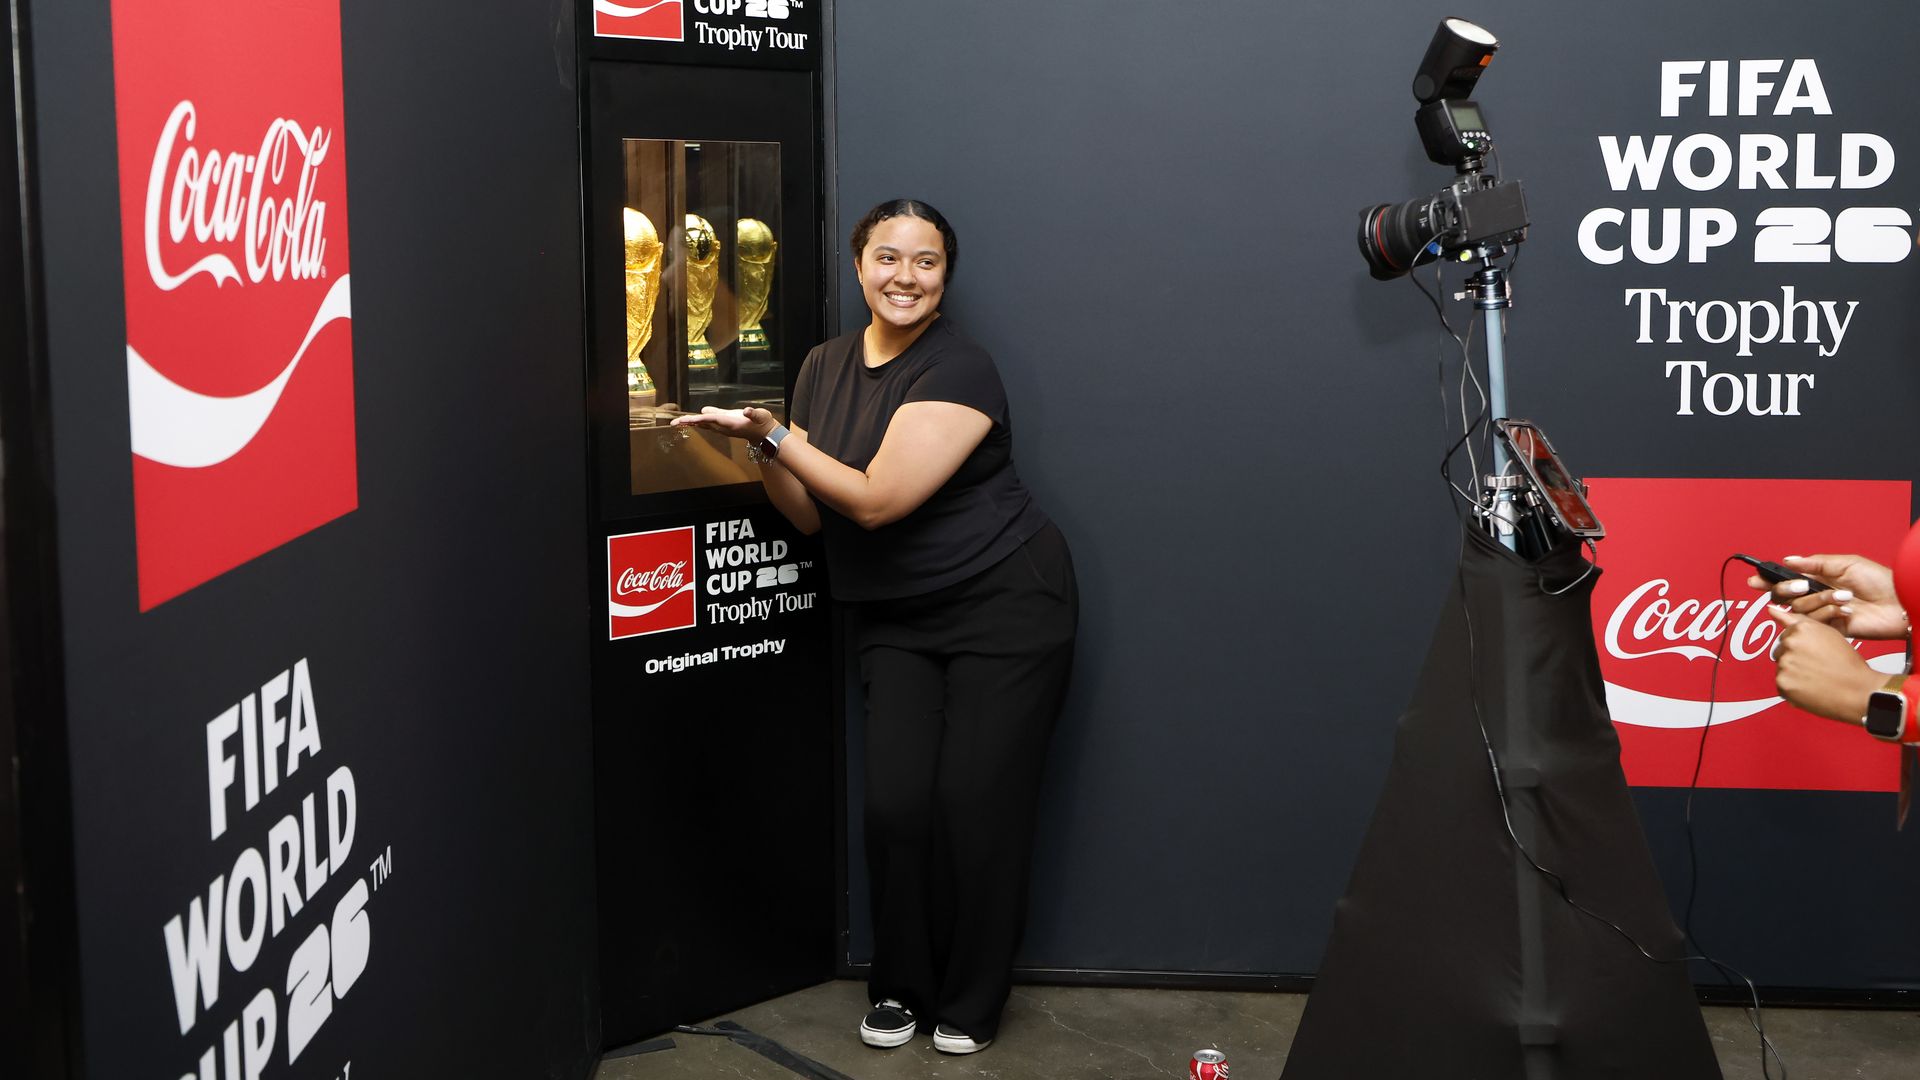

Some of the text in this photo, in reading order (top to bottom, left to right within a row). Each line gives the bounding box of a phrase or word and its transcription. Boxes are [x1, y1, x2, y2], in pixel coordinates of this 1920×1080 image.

[695, 21, 808, 51] Trophy Tour
[1661, 58, 1833, 117] FIFA
[1598, 132, 1896, 191] WORLD
[145, 99, 332, 291] Coca-Cola
[1577, 206, 1913, 265] CUP 26
[1625, 285, 1860, 357] Trophy
[1665, 360, 1815, 416] Tour
[705, 540, 788, 569] WORLD
[706, 518, 755, 544] FIFA
[616, 560, 688, 596] Coca-Cola
[706, 570, 752, 596] CUP
[756, 563, 799, 588] 26
[706, 592, 817, 624] Trophy Tour
[645, 639, 786, 674] Original Trophy
[206, 657, 322, 841] FIFA
[163, 765, 357, 1036] WORLD
[286, 878, 371, 1066] 26
